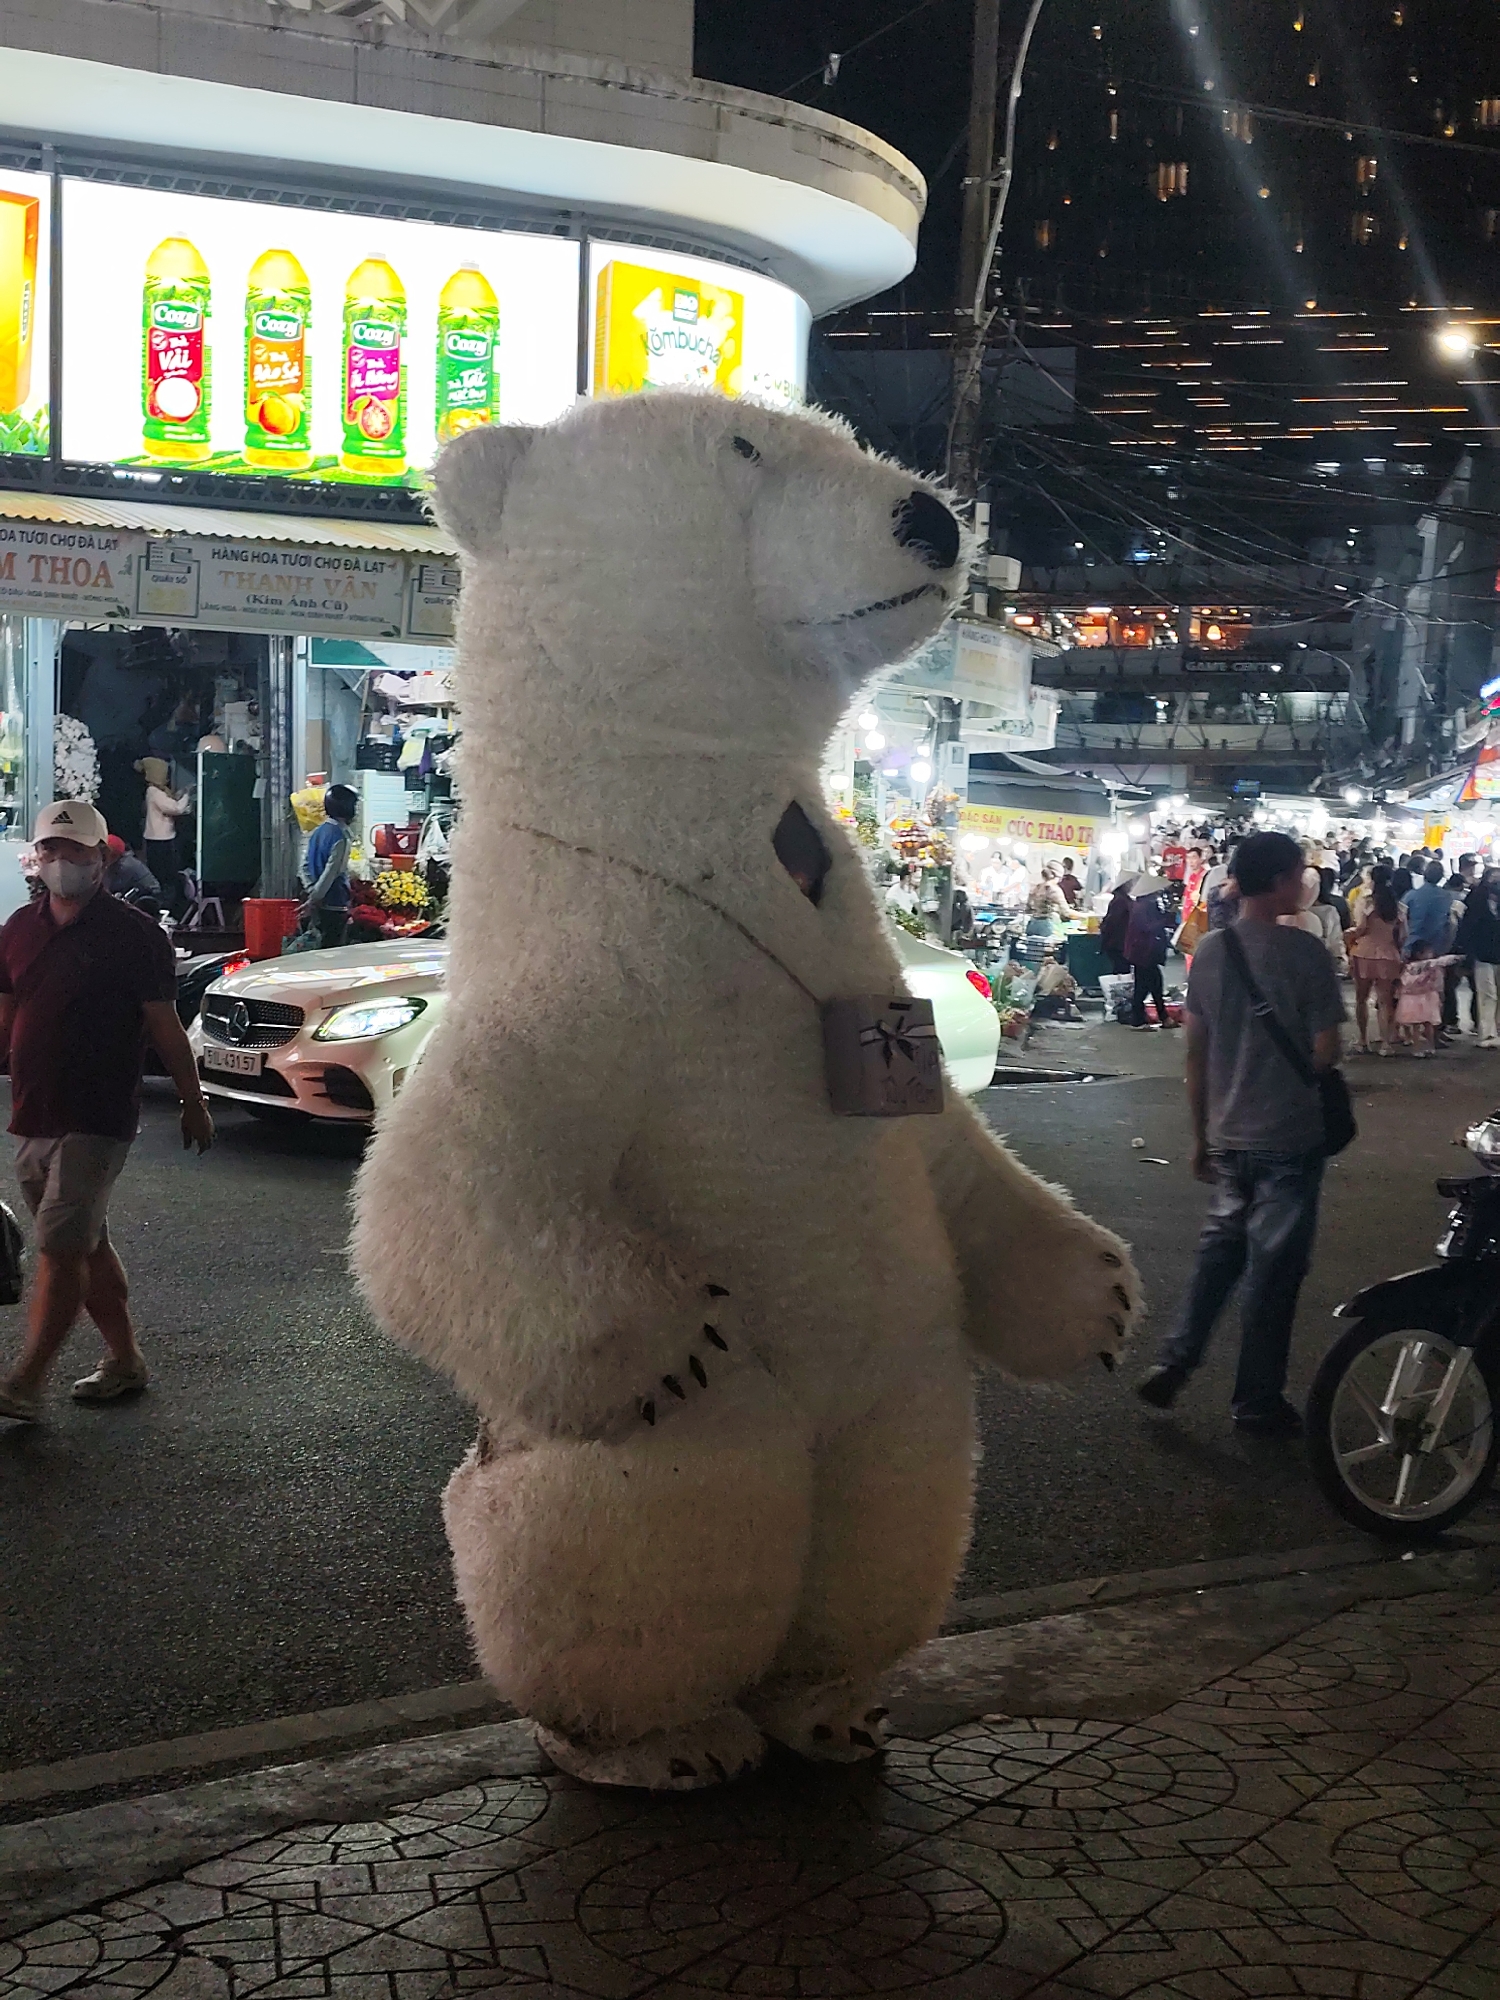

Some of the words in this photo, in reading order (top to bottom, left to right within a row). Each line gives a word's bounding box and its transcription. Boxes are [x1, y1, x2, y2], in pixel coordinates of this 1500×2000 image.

[154, 305, 198, 328] Cozy
[255, 315, 298, 337] Cozy
[353, 324, 395, 346] Cozy
[447, 334, 489, 357] Cozy
[18, 530, 48, 544] TƯƠI
[50, 533, 76, 550] CHỢ
[78, 535, 95, 549] ĐÀ
[98, 538, 119, 553] LẠT
[27, 554, 115, 588] THOA
[211, 546, 249, 562] HÀNG
[251, 550, 279, 565] HOA
[281, 553, 312, 568] TƯƠI
[315, 557, 342, 573] CHỢ
[344, 557, 361, 572] ĐÀ
[364, 560, 387, 576] LẠT
[218, 570, 314, 595] THANH
[324, 575, 379, 600] VÂN
[246, 593, 282, 606] (Kim
[288, 594, 318, 609] Ánh
[1007, 816, 1034, 838] CÚC
[1038, 817, 1074, 842] THẢO
